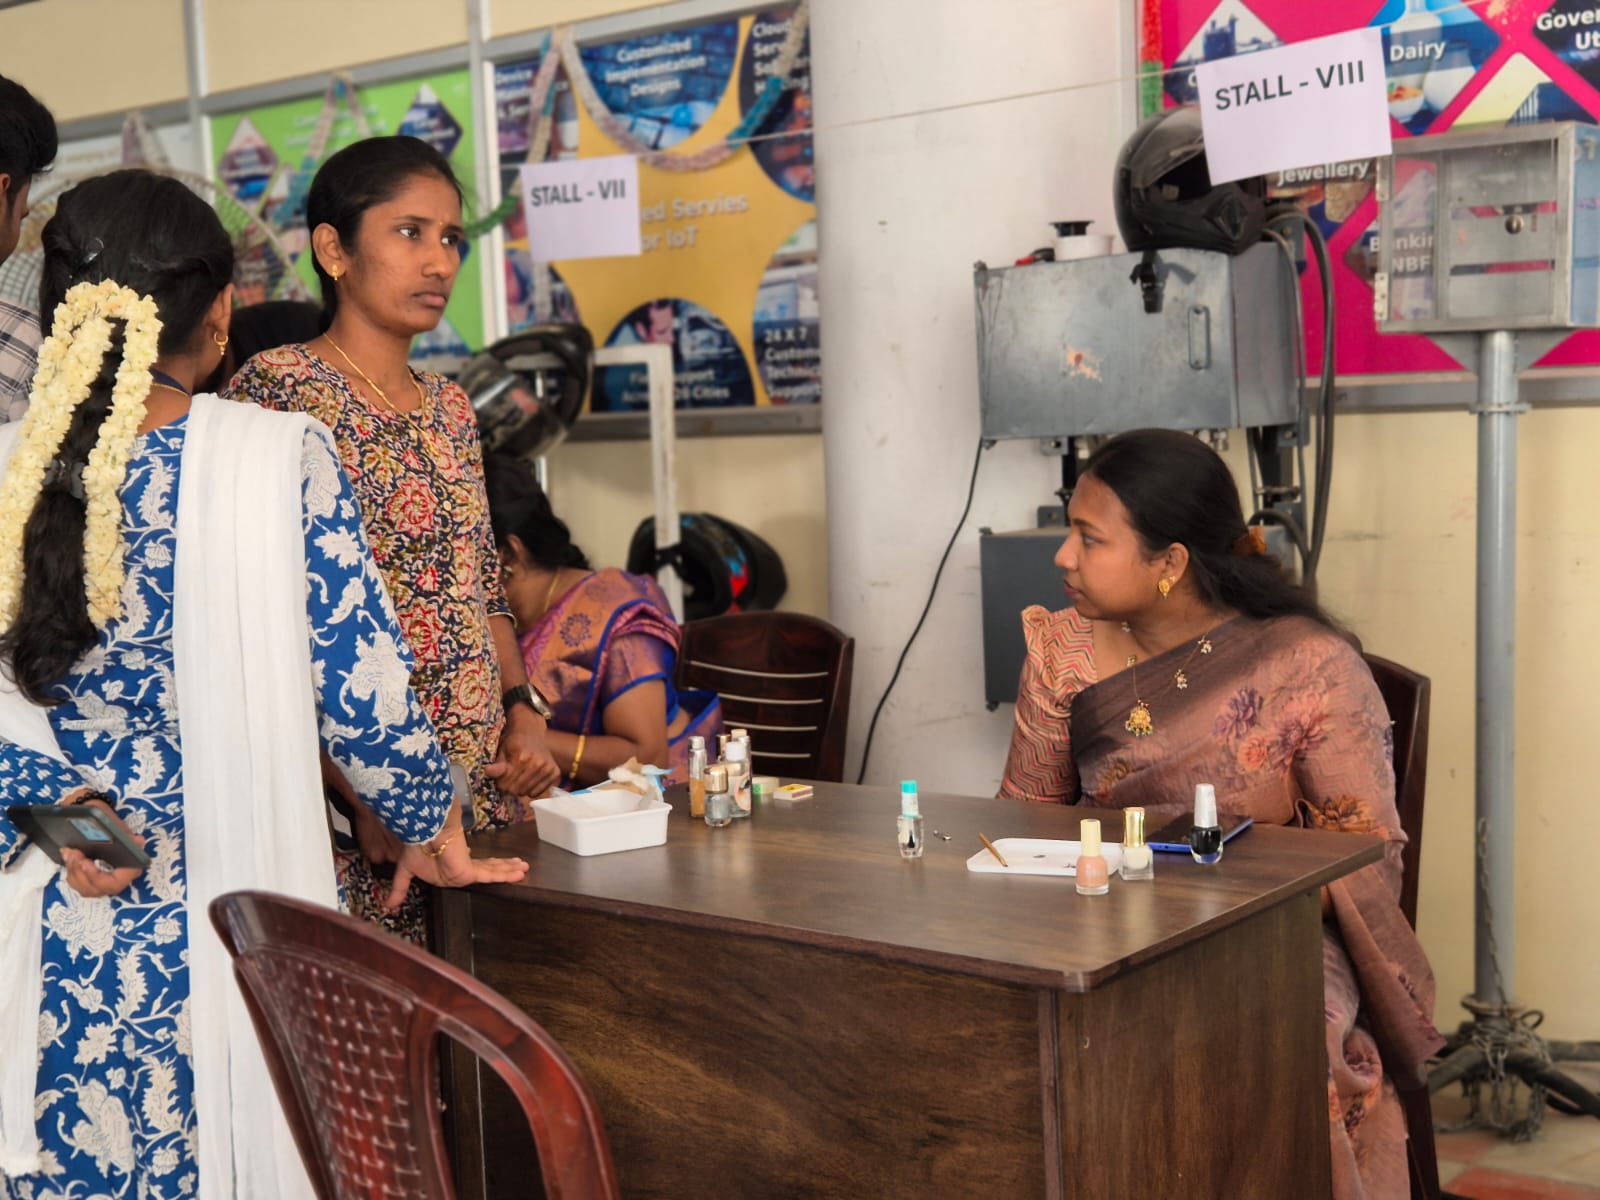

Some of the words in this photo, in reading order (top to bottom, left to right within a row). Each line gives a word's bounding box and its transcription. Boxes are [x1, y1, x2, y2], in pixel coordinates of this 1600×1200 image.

[616, 37, 692, 63] Customized
[1390, 41, 1446, 63] Dairy
[604, 55, 706, 83] Implementation
[630, 79, 682, 97] Designs
[1215, 75, 1292, 110] STALL
[1316, 60, 1364, 89] VIII
[1278, 161, 1369, 186] Jewellery
[531, 184, 582, 207] STALL
[598, 179, 625, 200] VII
[672, 194, 748, 219] Servies
[667, 226, 698, 247] IoT
[799, 326, 808, 340] 7
